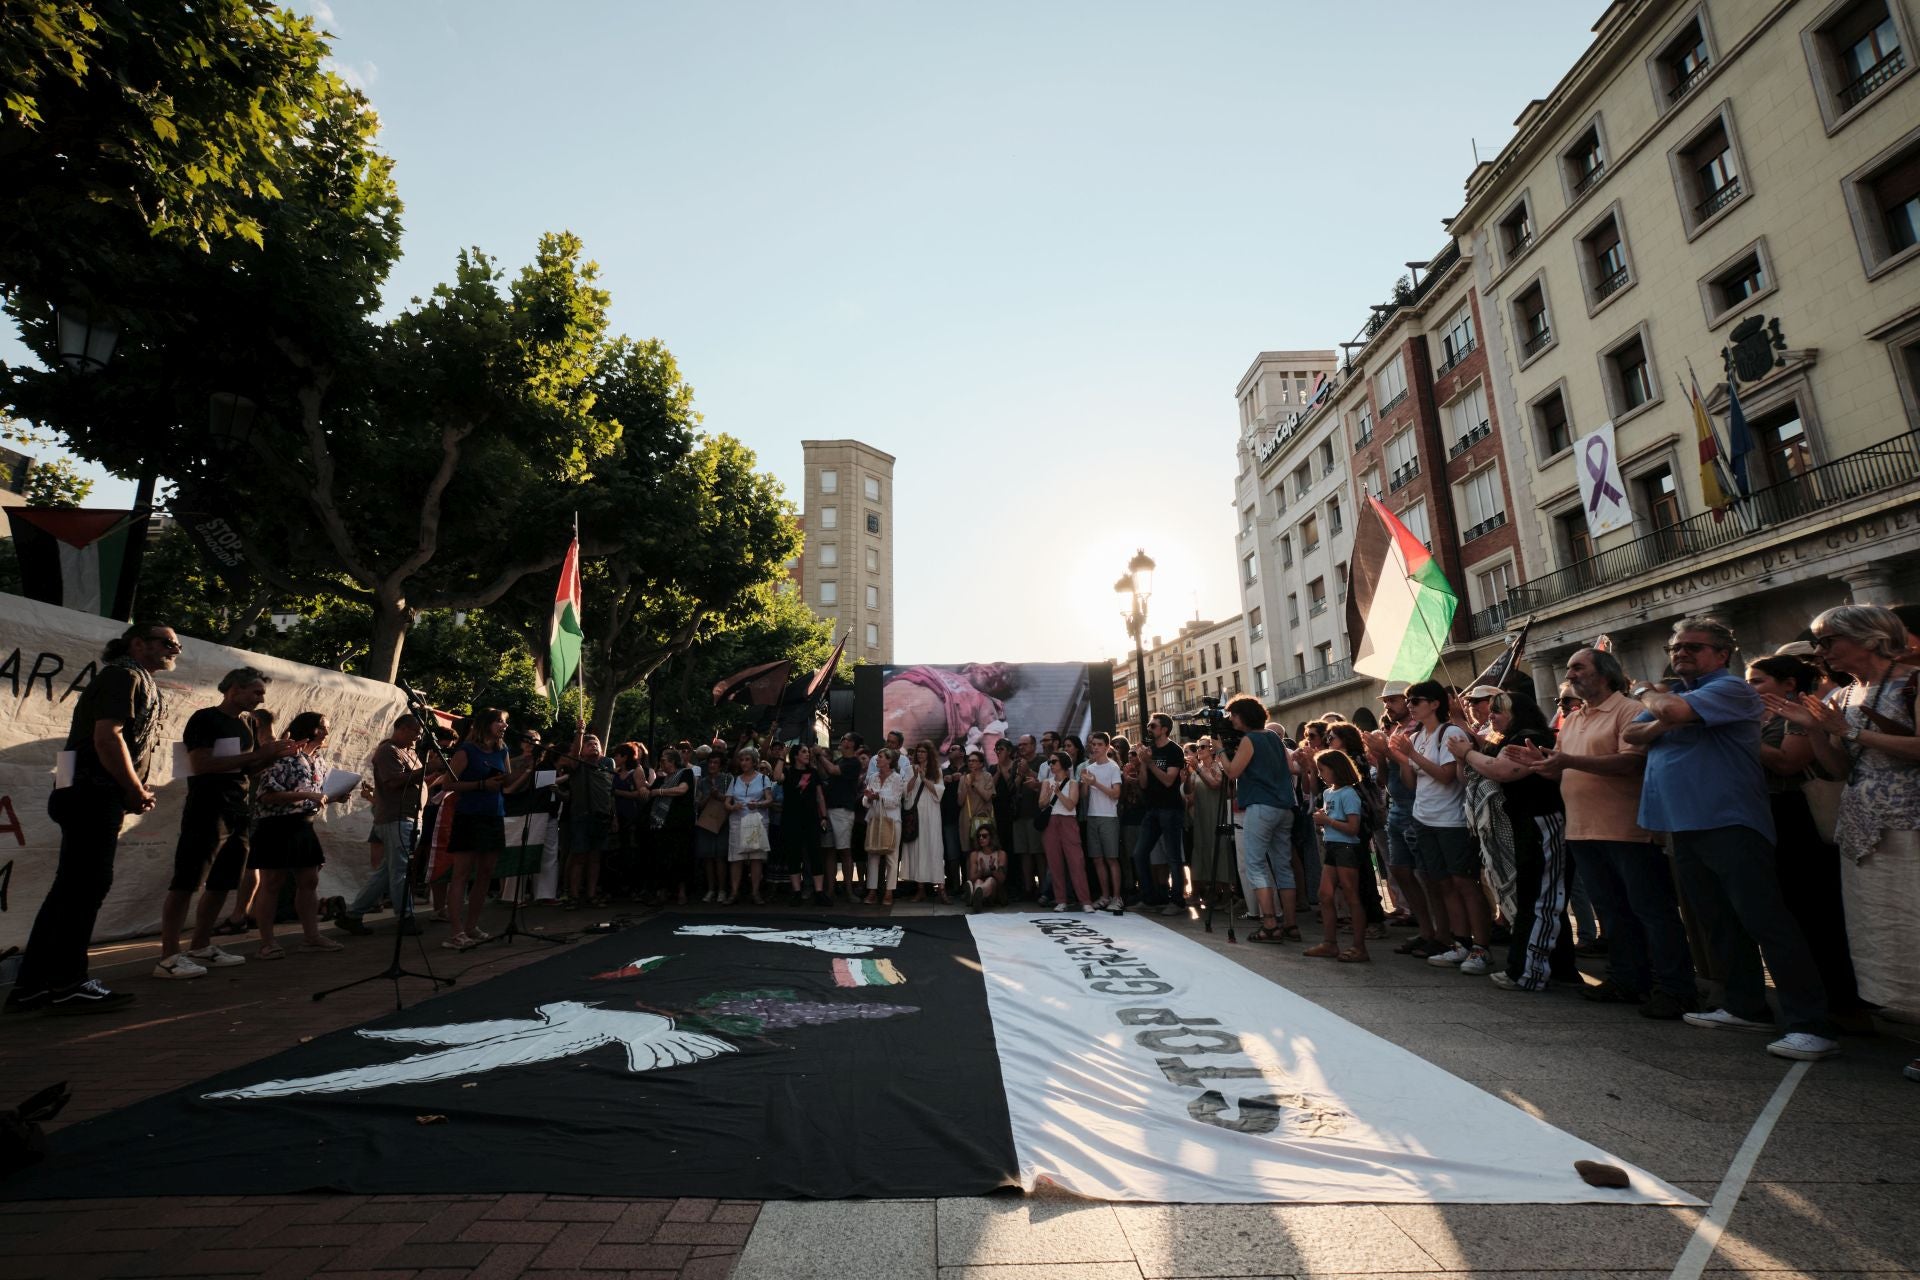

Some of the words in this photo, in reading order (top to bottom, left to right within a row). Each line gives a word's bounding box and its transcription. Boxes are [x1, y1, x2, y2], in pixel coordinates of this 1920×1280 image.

[207, 518, 243, 549] STOP
[1628, 563, 1744, 609] DELEGACION
[1761, 546, 1807, 570] DEL
[1030, 918, 1175, 995] GENOCIDIO
[1116, 1007, 1348, 1137] STOP
